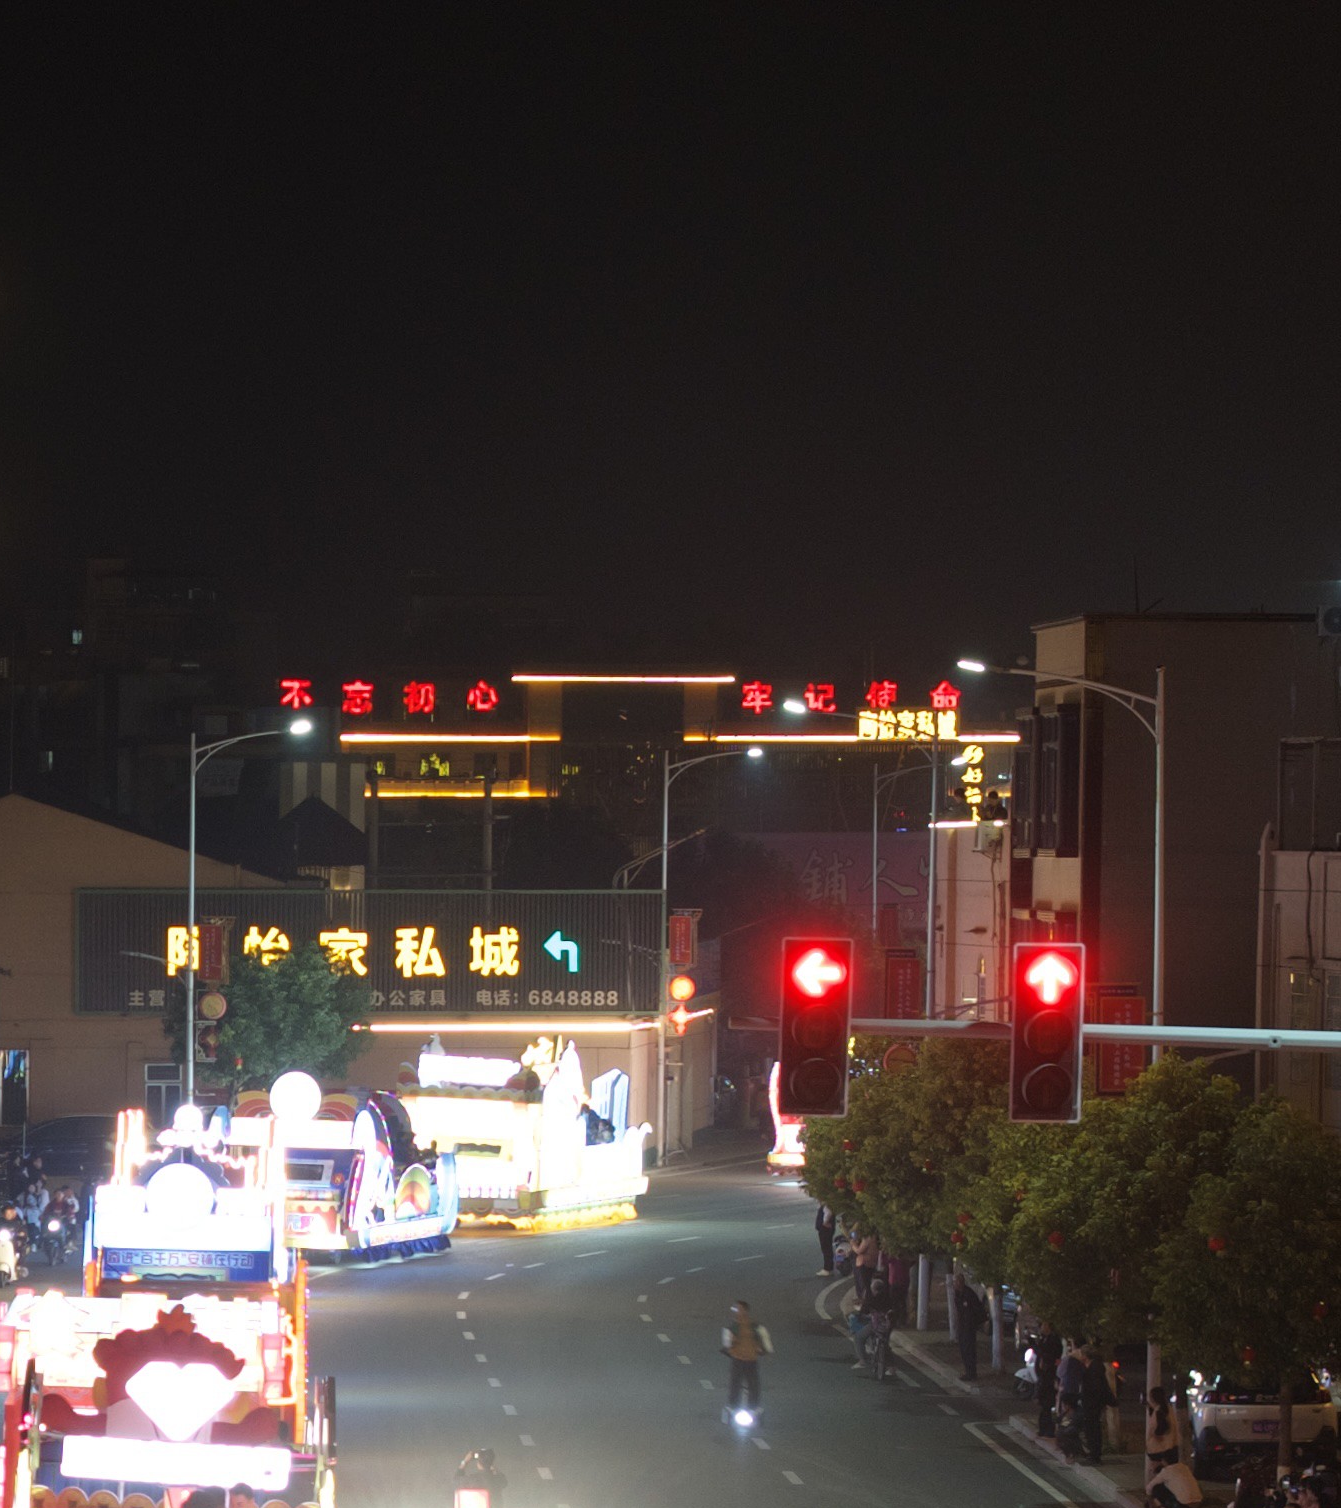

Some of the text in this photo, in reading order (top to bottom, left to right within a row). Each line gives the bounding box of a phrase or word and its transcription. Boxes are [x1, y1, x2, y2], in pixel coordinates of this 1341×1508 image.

[279, 679, 962, 714] 不忘初心 牢记使命
[128, 989, 165, 1007] 主营
[370, 989, 446, 1006] 办公家具
